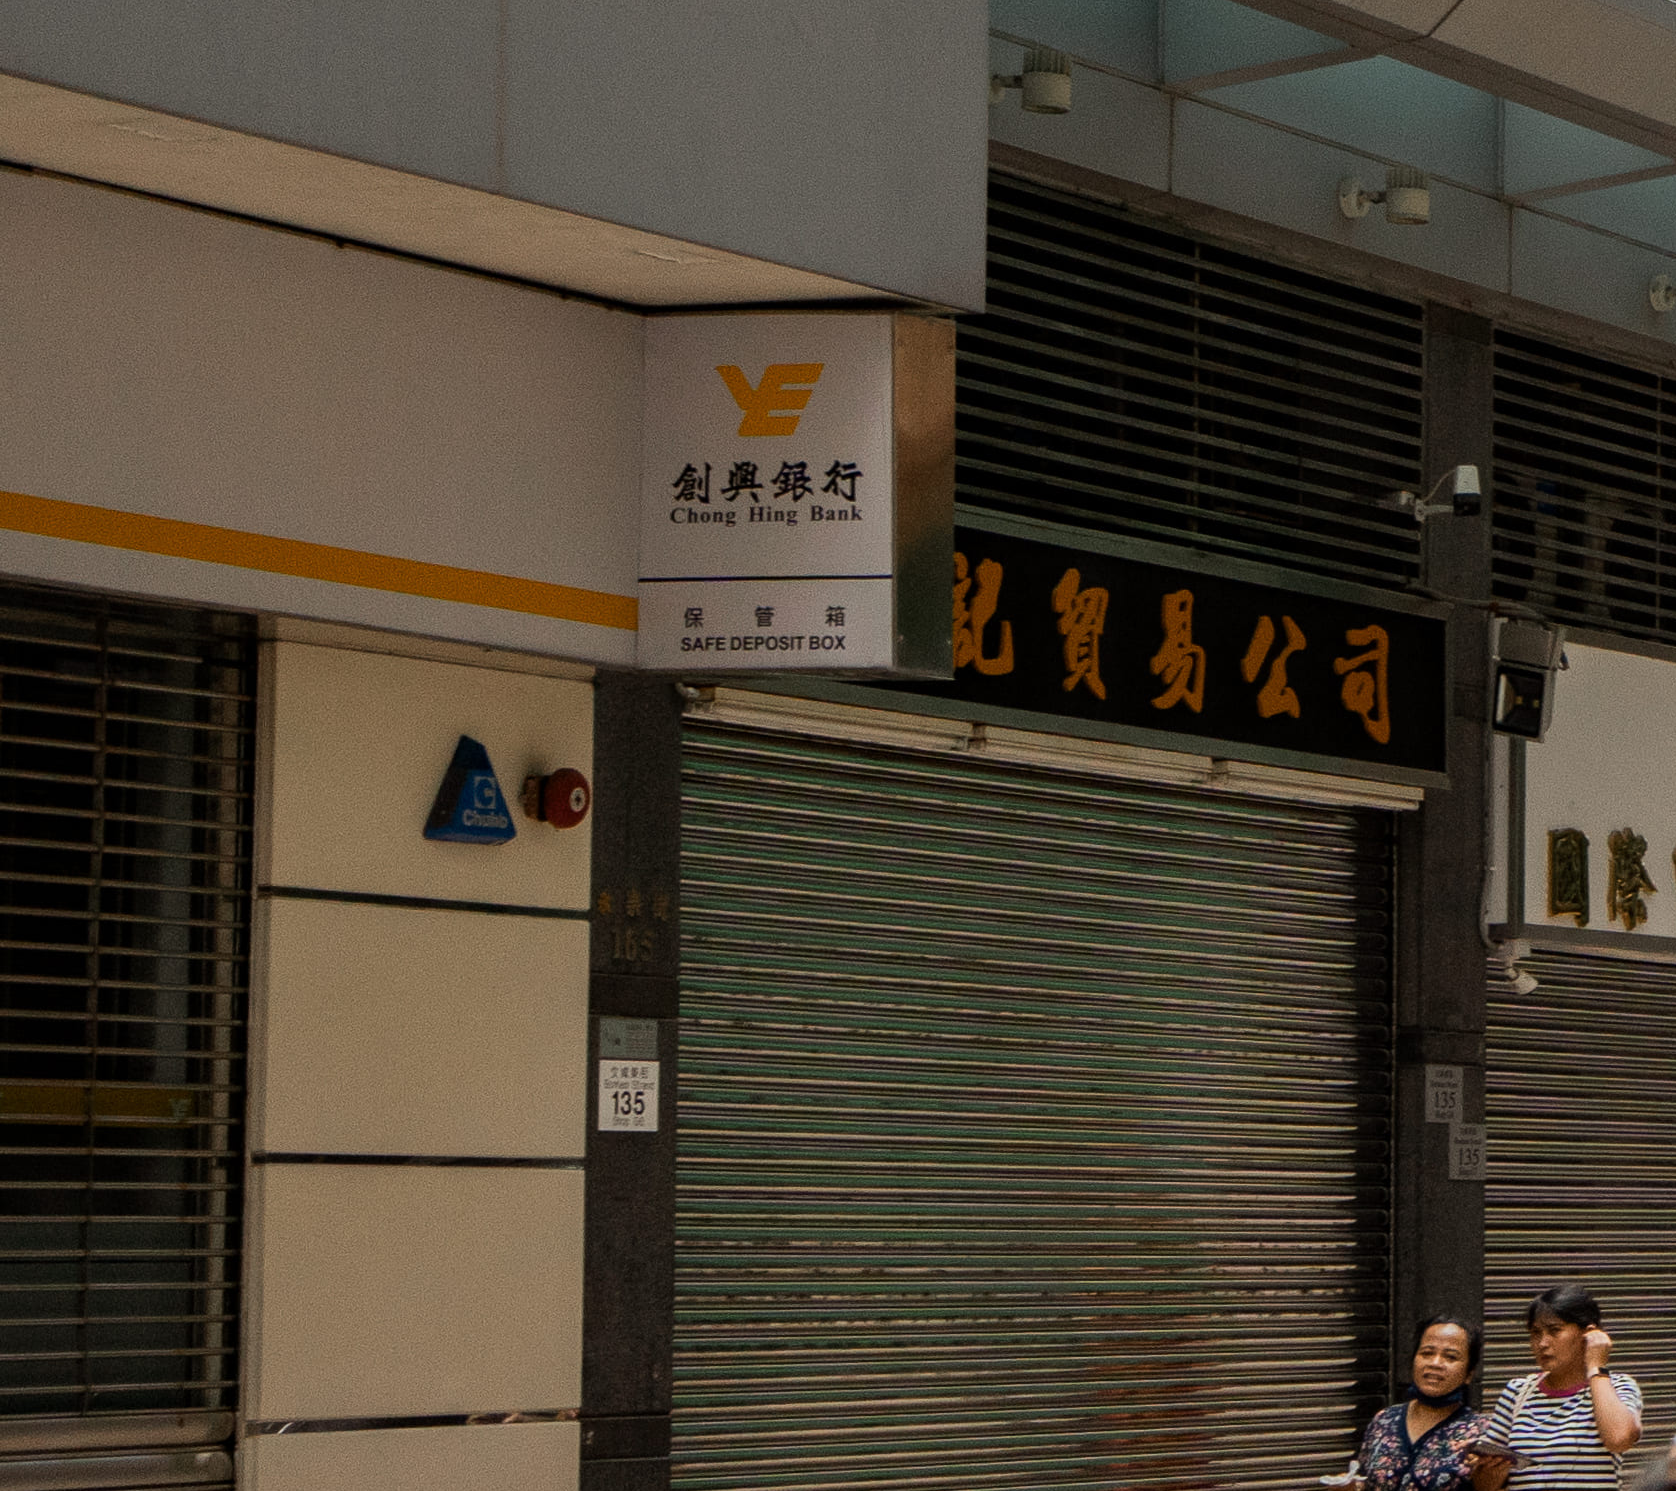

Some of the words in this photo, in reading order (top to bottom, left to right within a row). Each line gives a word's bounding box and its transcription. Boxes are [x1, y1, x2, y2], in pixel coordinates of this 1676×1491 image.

[671, 460, 864, 505] 創興銀行
[670, 504, 736, 527] Chong
[748, 504, 799, 526] Hing
[810, 503, 864, 523] Bank
[684, 604, 846, 629] 保管箱
[680, 635, 728, 653] SAFE
[729, 635, 806, 653] DEPOSIT
[808, 634, 846, 652] BOX
[612, 1091, 645, 1115] 135
